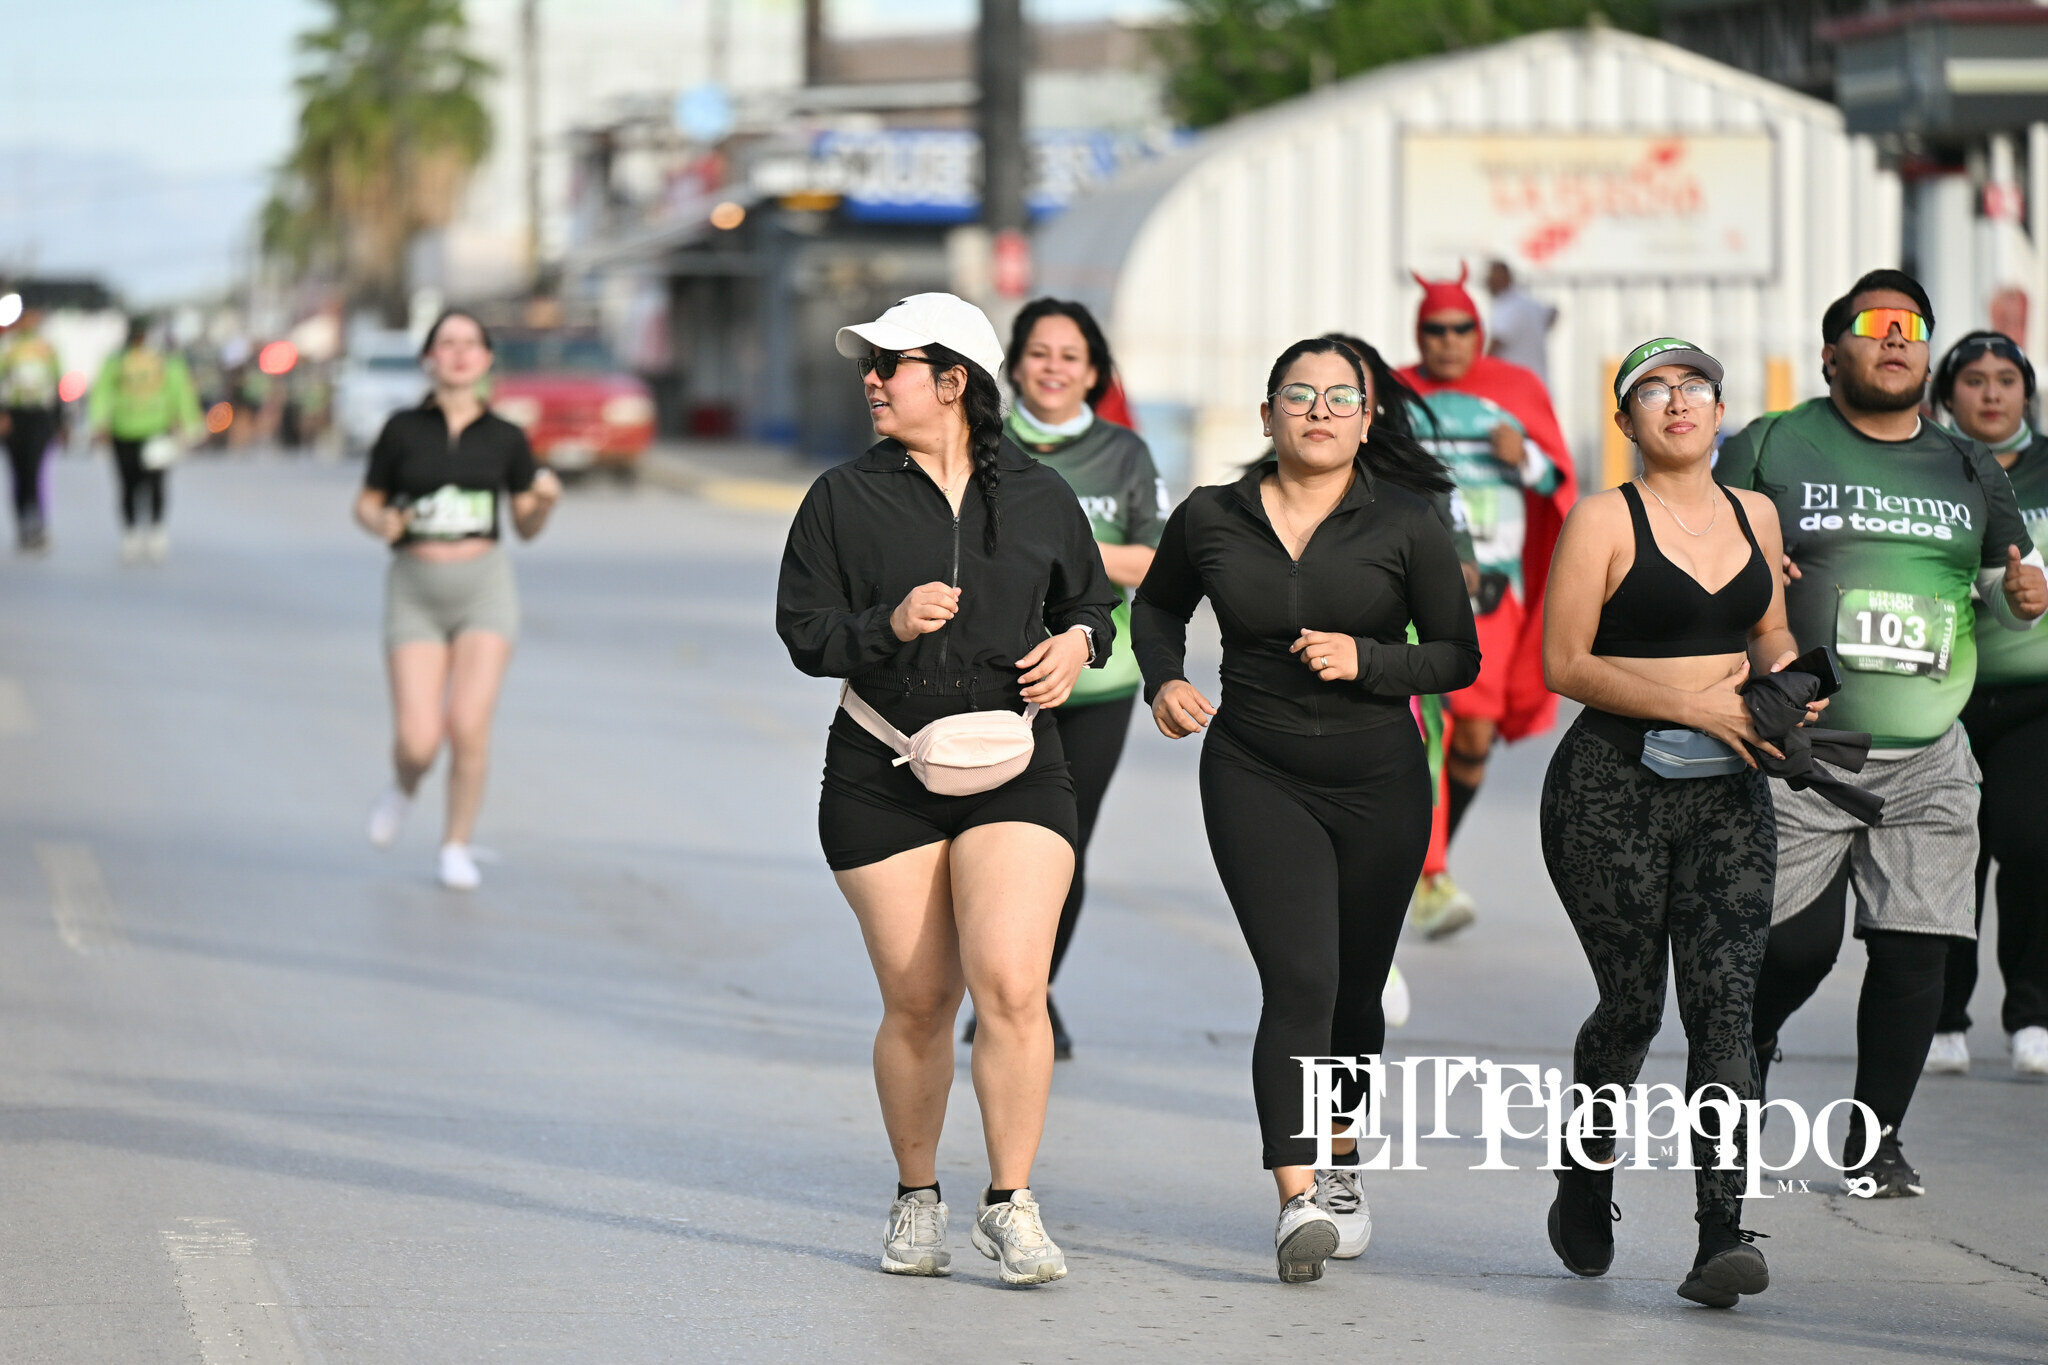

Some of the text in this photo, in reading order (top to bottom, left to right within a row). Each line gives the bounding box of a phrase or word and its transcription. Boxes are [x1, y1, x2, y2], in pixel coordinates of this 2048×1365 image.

[1800, 482, 1971, 525] El Tiempo
[1800, 512, 1953, 540] de todos
[1856, 611, 1926, 649] 103
[1938, 617, 1953, 670] MEDALLA
